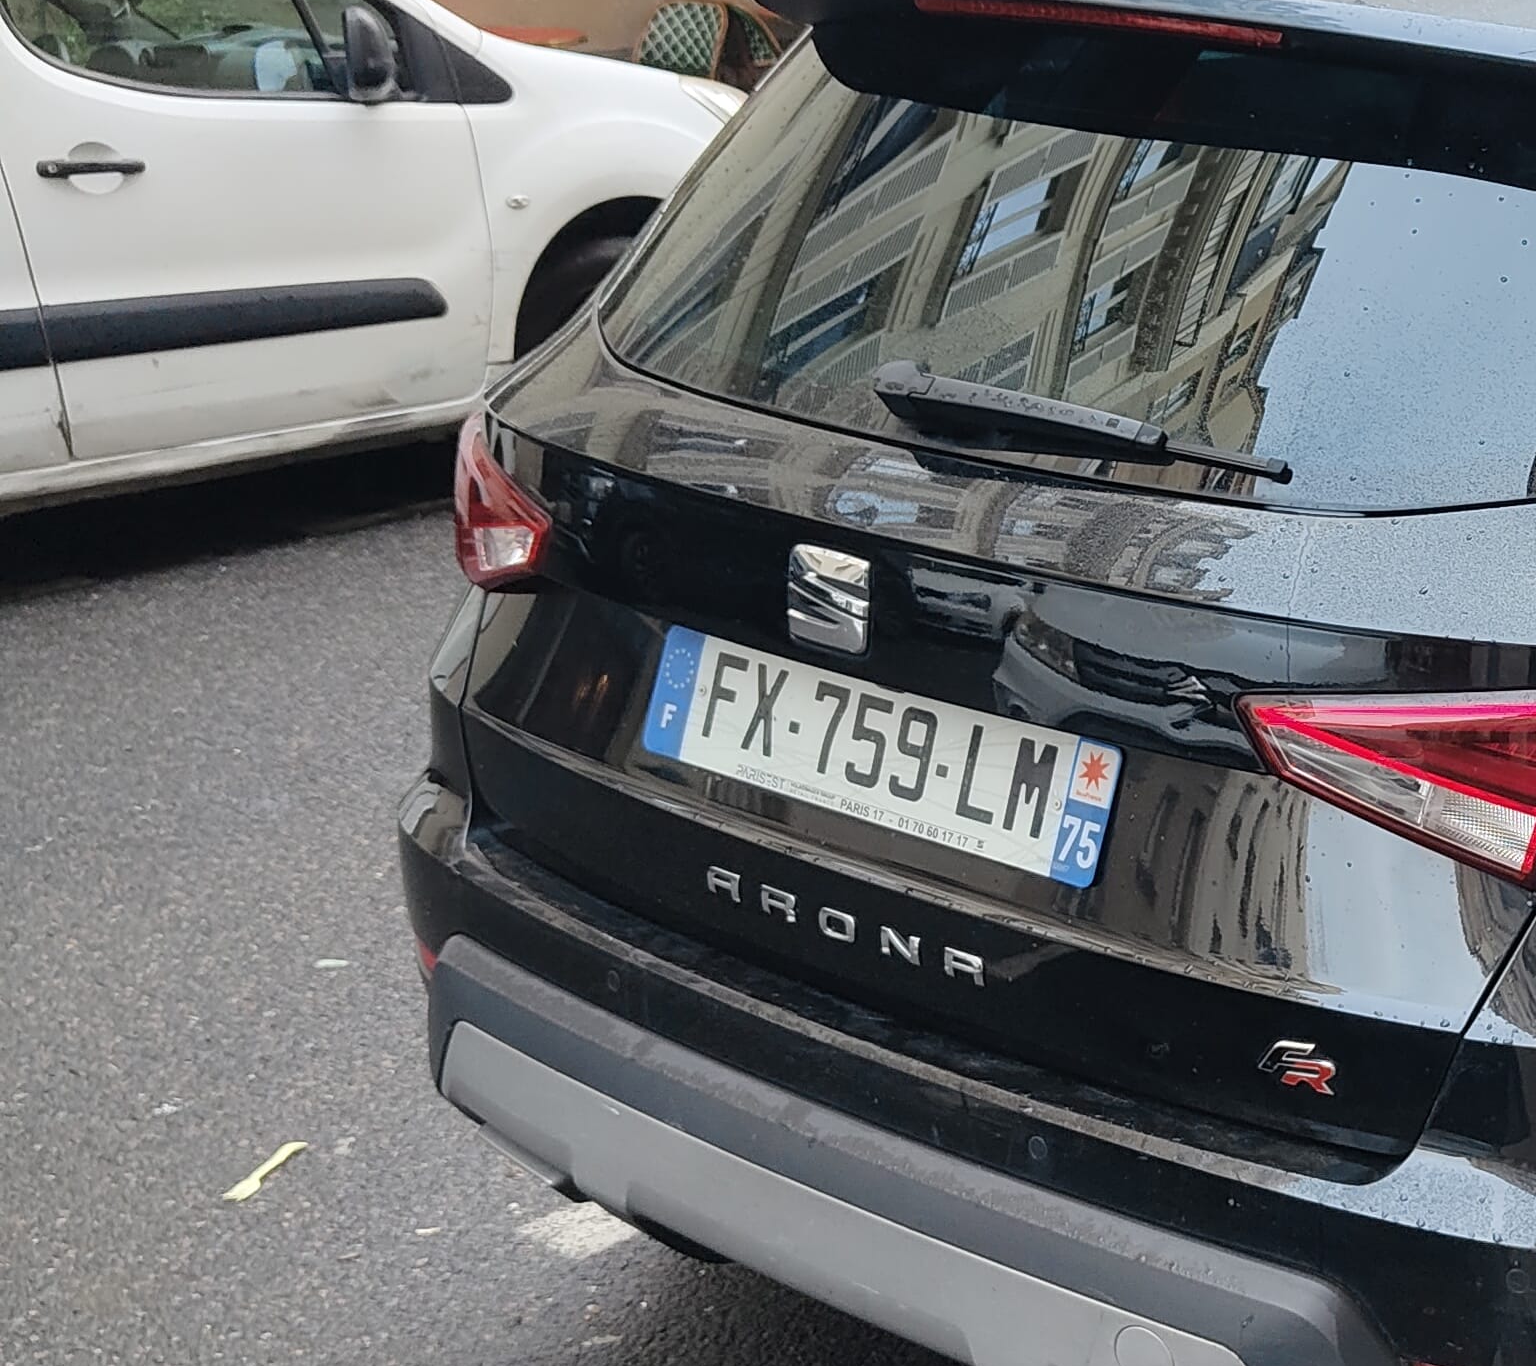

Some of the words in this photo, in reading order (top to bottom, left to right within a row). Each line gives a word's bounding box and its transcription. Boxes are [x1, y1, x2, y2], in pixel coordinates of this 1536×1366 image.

[660, 702, 678, 729] F
[840, 798, 870, 817] PARIS
[873, 809, 884, 821] 17
[898, 817, 909, 830] 01
[913, 822, 924, 834] 70
[927, 825, 939, 839] 60
[942, 830, 954, 843] 17
[957, 835, 969, 848] 17
[1057, 814, 1102, 869] 75
[707, 865, 985, 987] ARONA
[1257, 1039, 1336, 1096] FR
